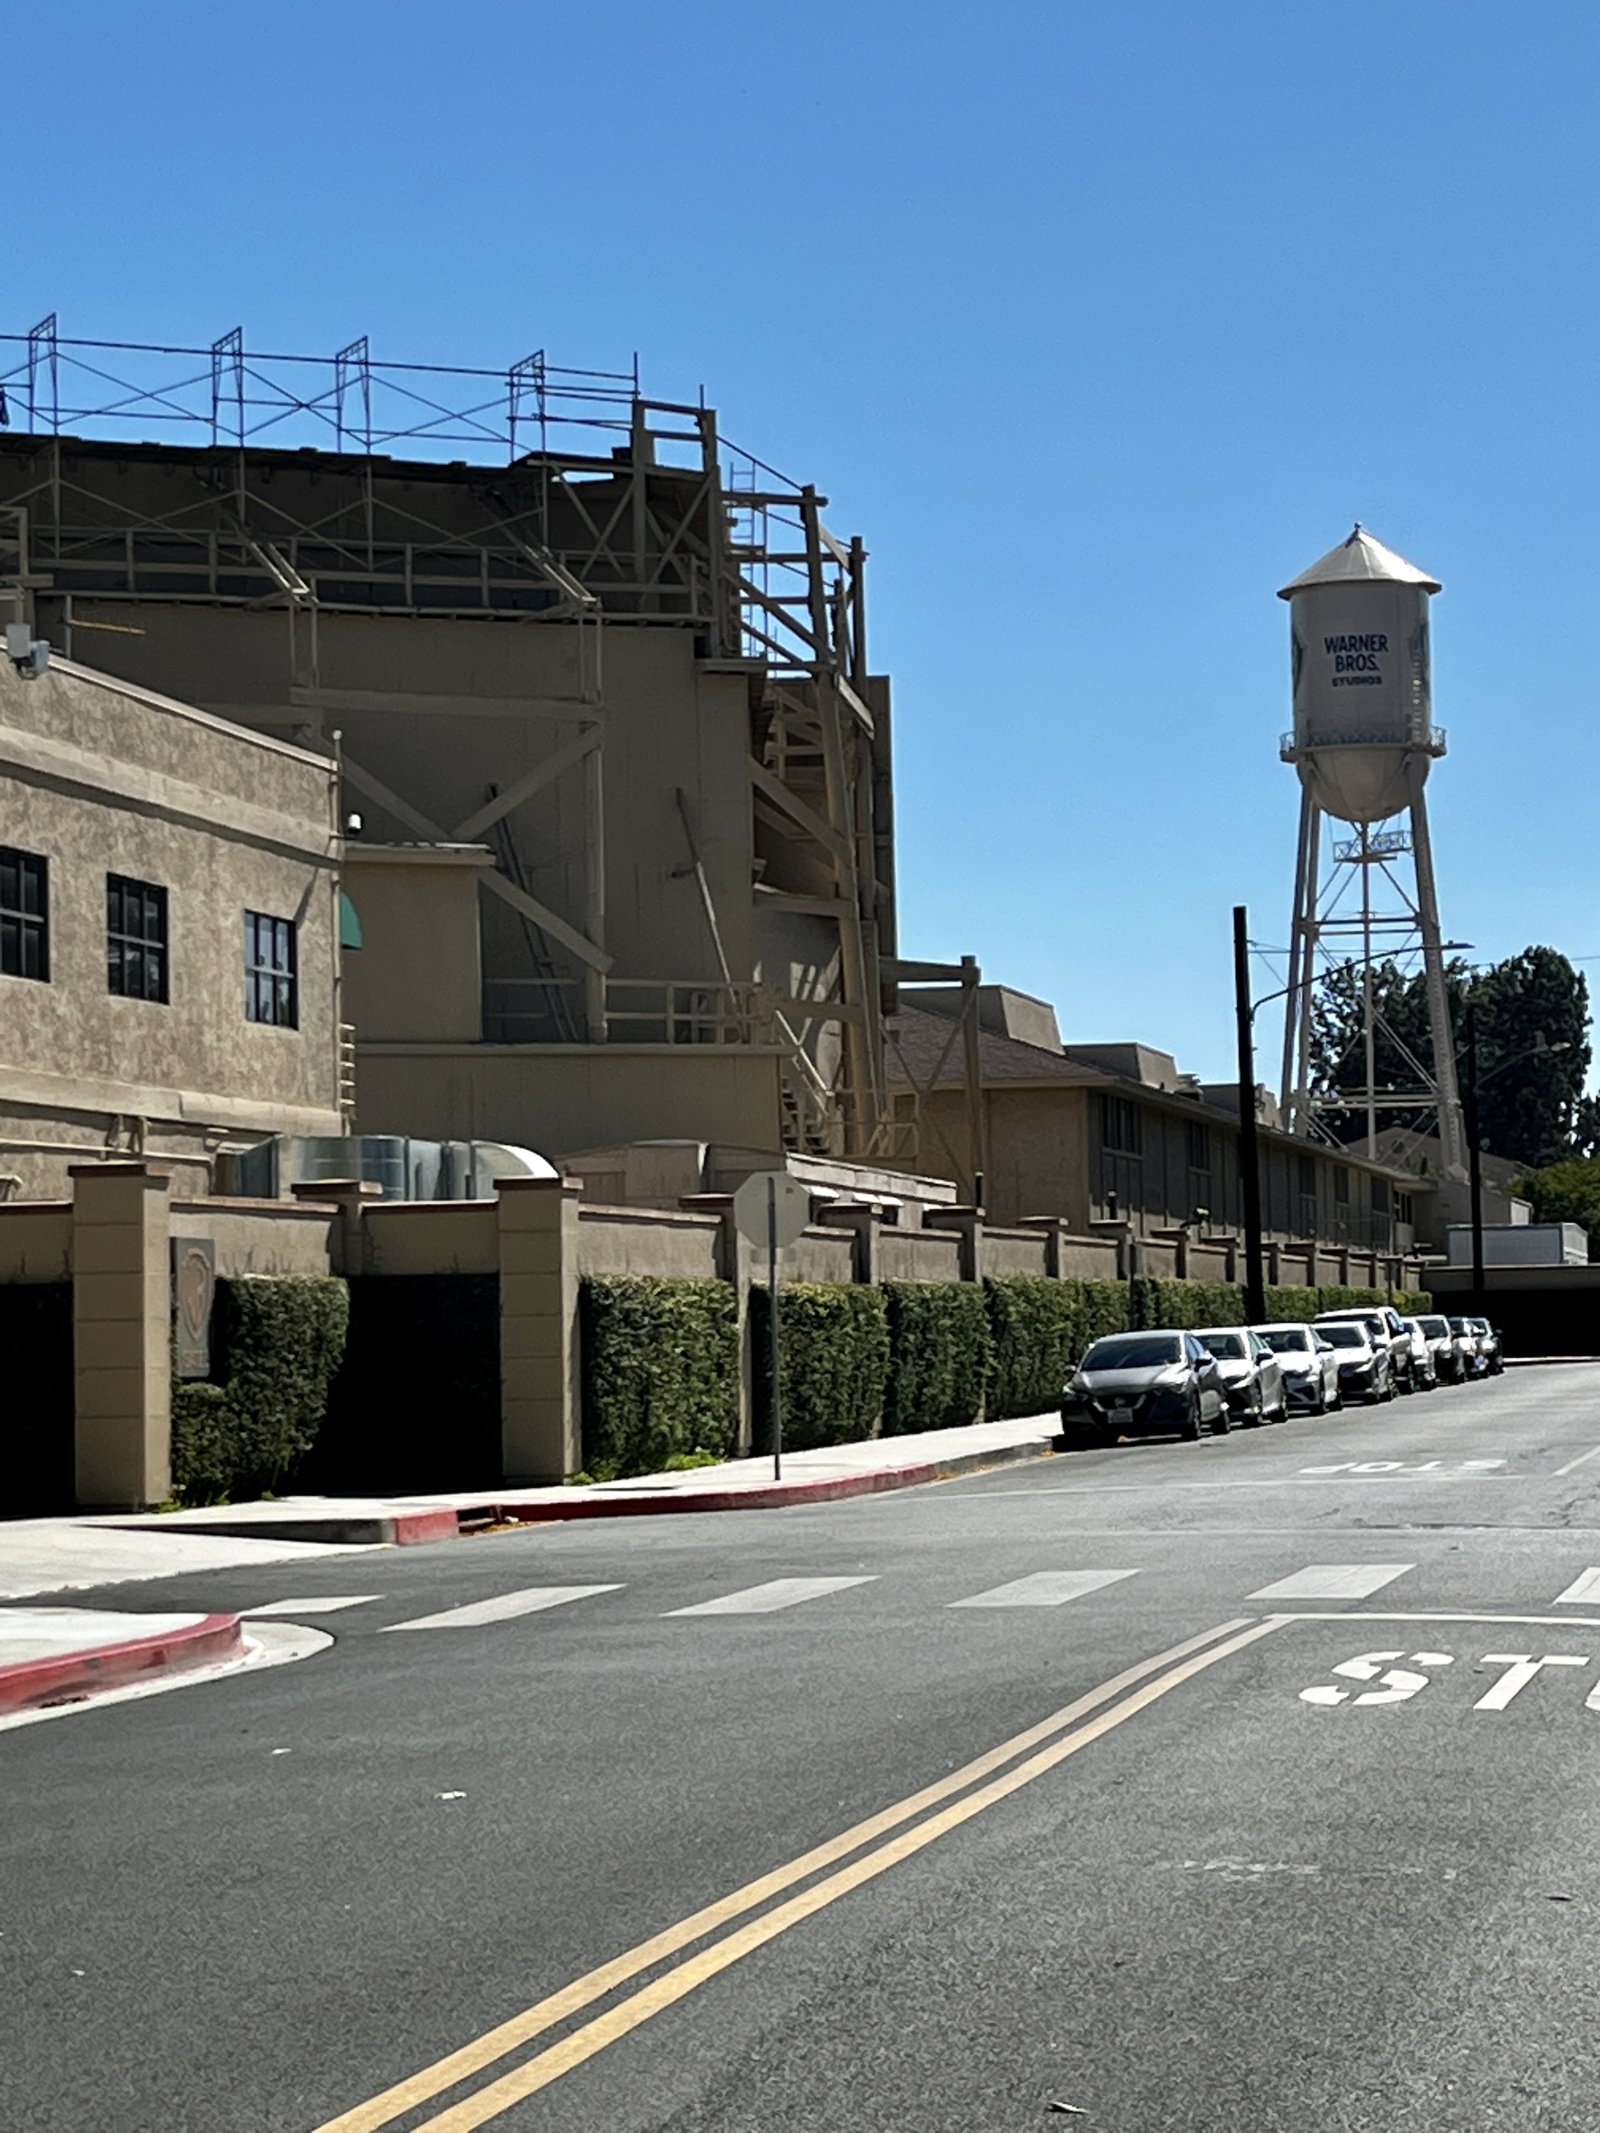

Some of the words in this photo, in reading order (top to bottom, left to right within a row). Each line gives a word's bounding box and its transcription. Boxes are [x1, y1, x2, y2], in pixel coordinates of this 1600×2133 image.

[1324, 634, 1388, 653] WARNER
[1335, 654, 1380, 672] BROS.
[1332, 675, 1382, 687] STUDIOS
[1298, 1651, 1600, 1713] ST
